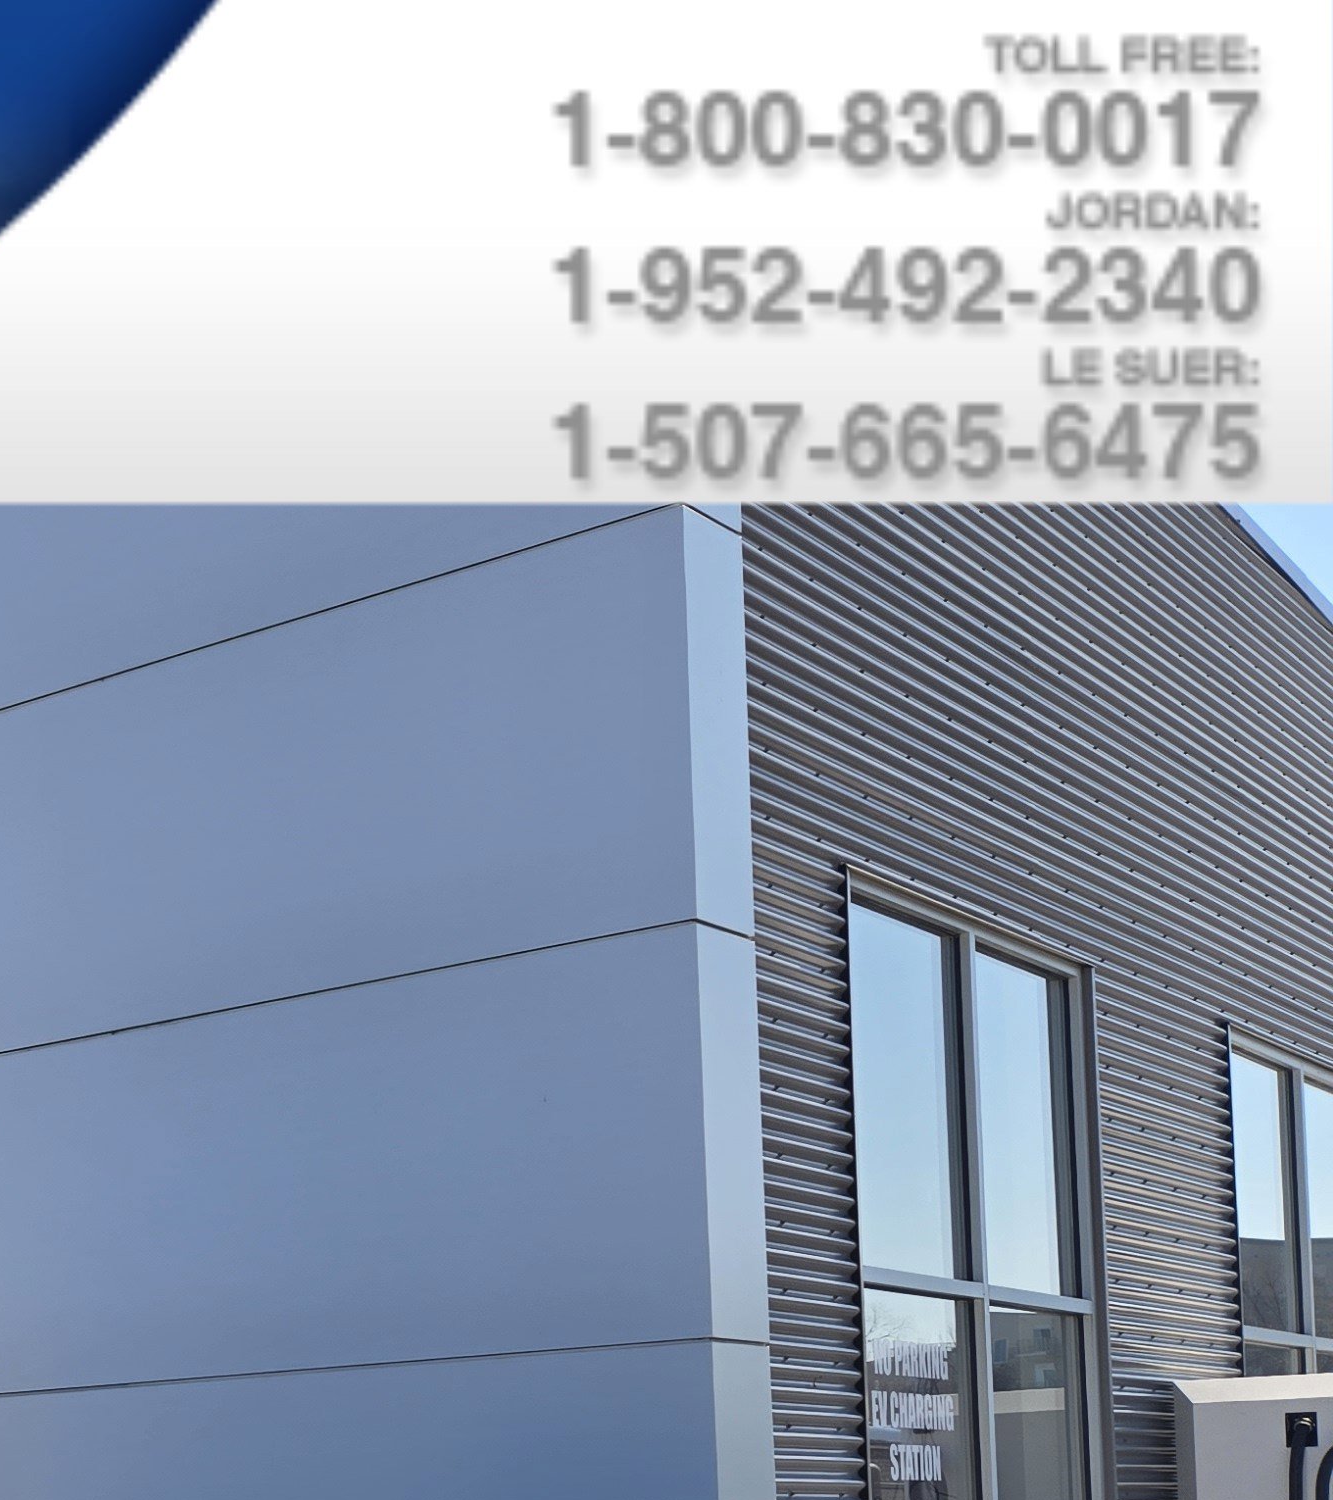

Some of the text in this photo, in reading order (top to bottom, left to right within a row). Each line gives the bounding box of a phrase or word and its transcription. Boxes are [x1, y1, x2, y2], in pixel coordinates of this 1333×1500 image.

[874, 1340, 949, 1380] NO PARKING
[889, 1390, 954, 1431] CHARGING
[889, 1443, 942, 1481] STATION
